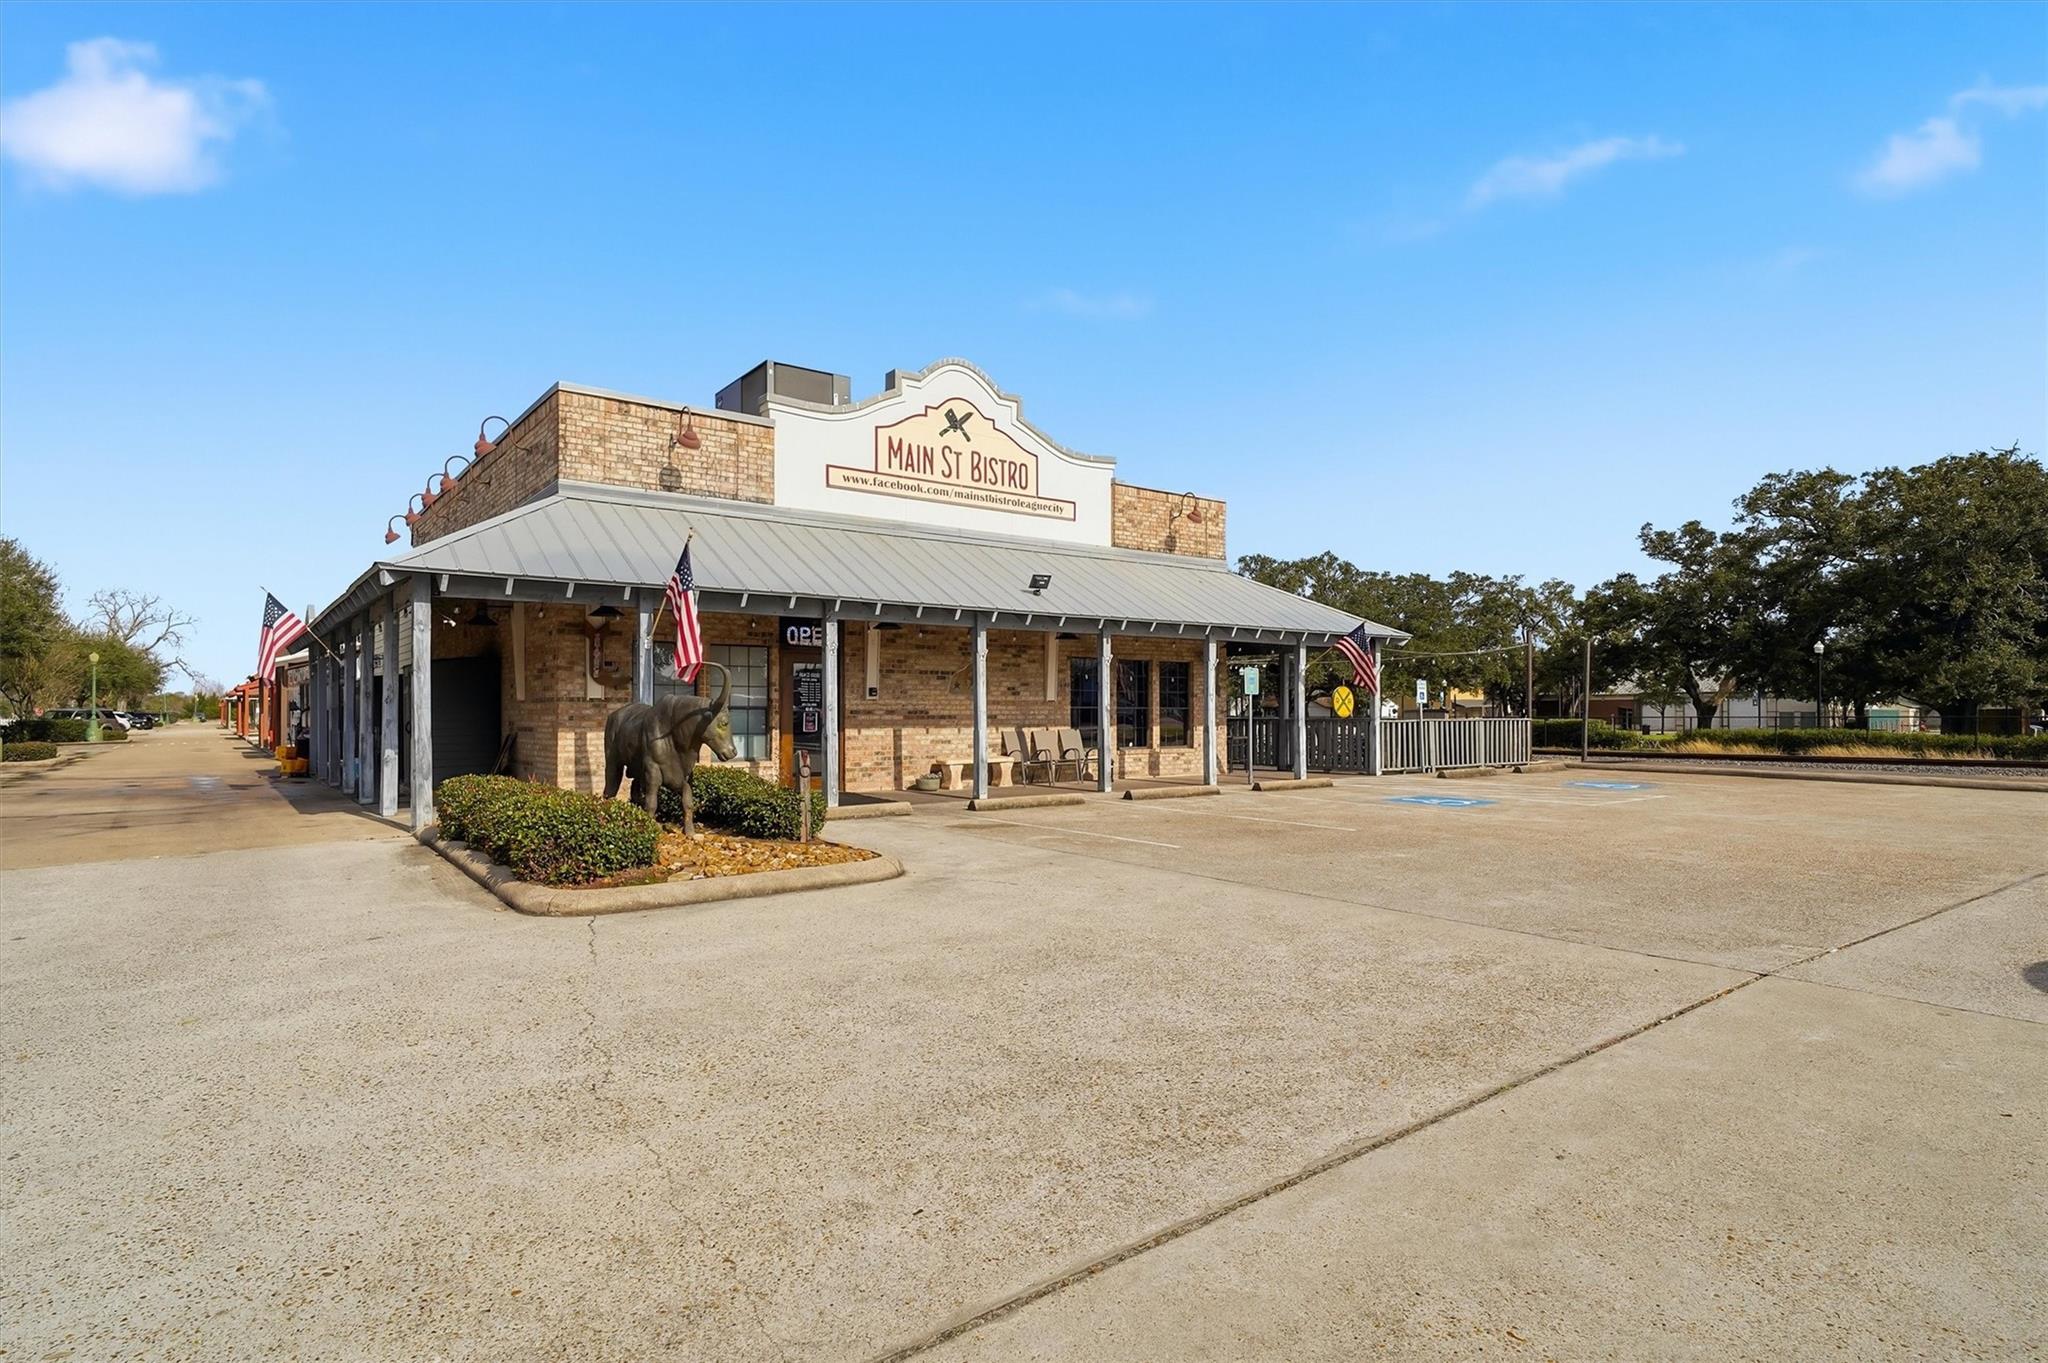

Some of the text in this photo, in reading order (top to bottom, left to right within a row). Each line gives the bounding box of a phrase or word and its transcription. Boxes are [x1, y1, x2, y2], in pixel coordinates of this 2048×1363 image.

[888, 435, 1029, 490] MAIN ST BISTRO
[842, 474, 1065, 515] www.facebook.com/mainstbistroleaguecity
[786, 626, 822, 647] OPE
